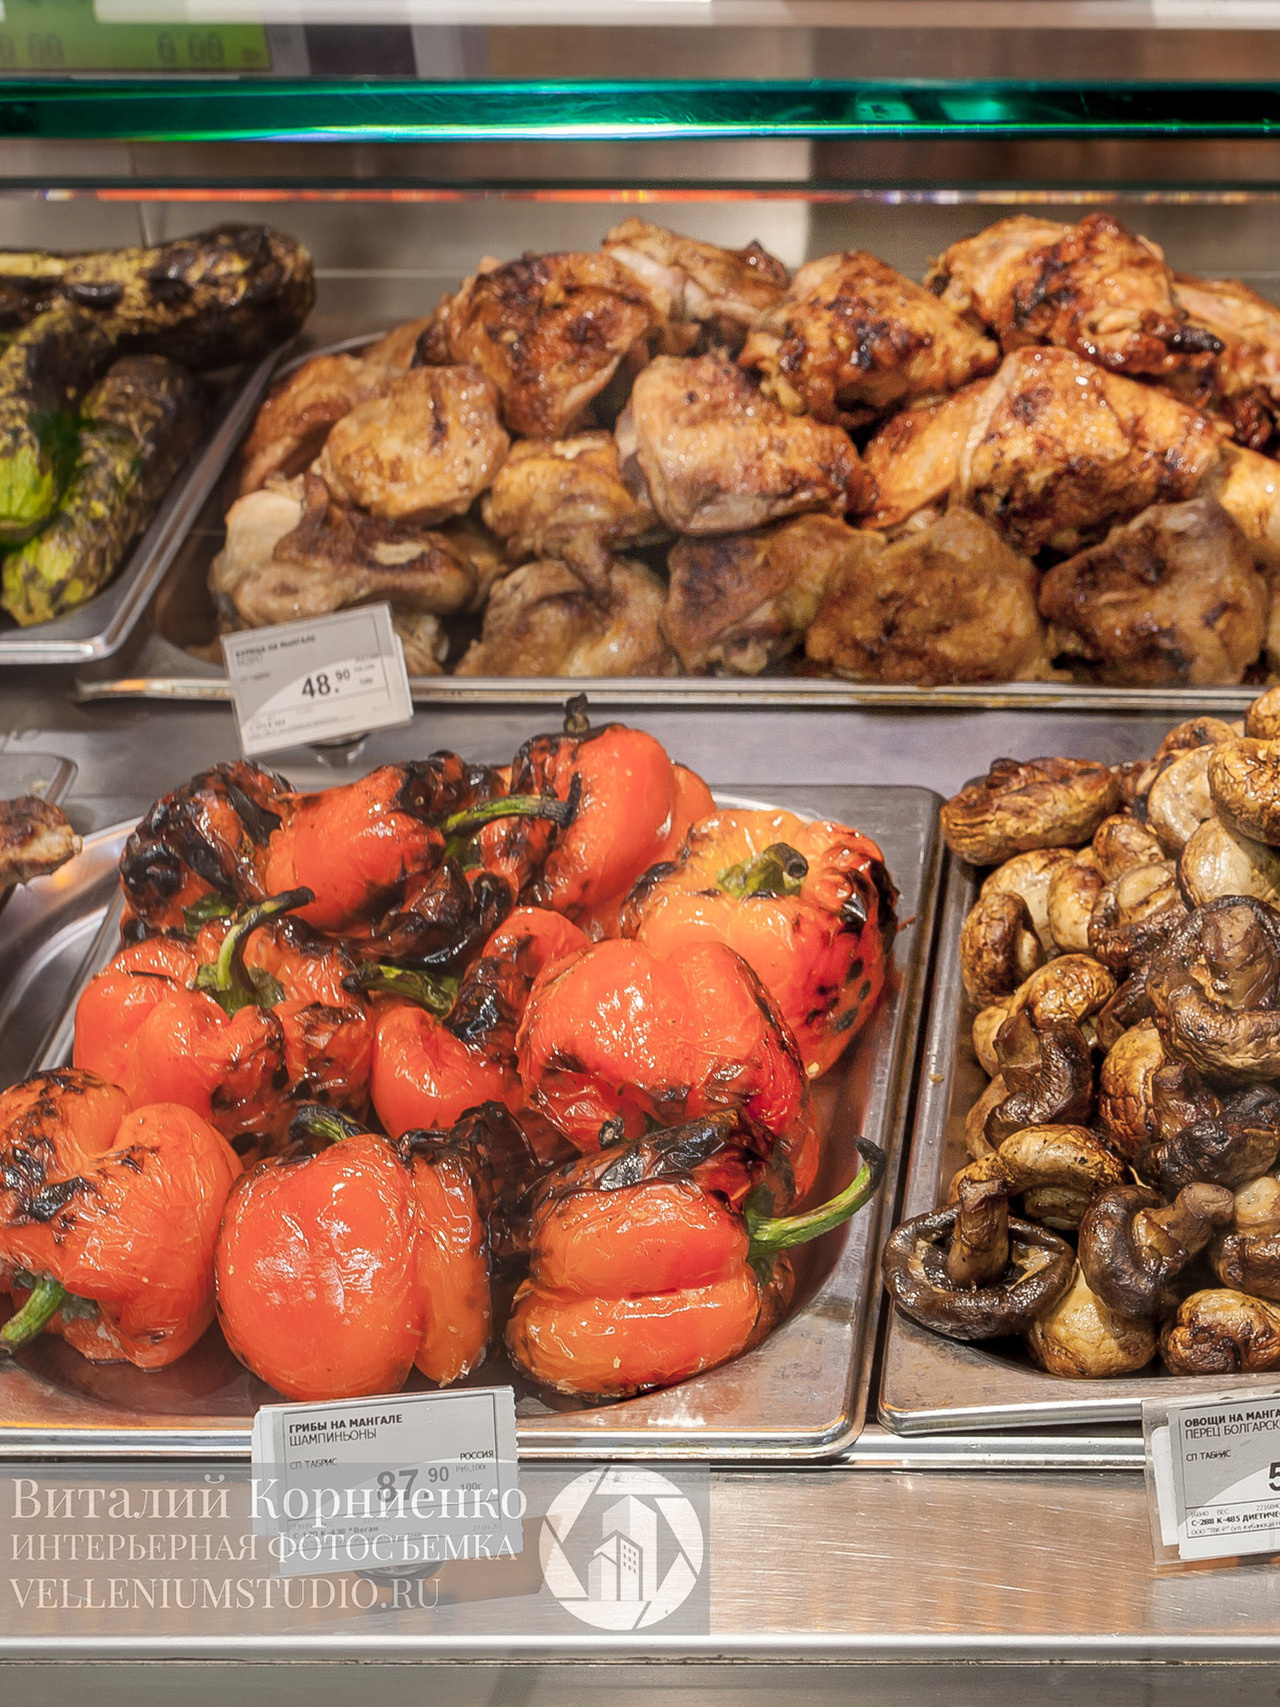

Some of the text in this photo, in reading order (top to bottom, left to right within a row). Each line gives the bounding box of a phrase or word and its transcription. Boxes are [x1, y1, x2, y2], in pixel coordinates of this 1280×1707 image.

[289, 1413, 403, 1434] ГРИБЫ НА МАНГАЛЕ
[1184, 1415, 1226, 1428] ОВОЩИ
[1229, 1412, 1244, 1423] НА
[289, 1428, 377, 1447] ШАМПИНЬОНЫ
[1185, 1425, 1221, 1440] ПЕРЕЦ
[459, 1449, 494, 1460] РОССИЯ
[1186, 1449, 1232, 1462] СП ТАБРИС
[290, 1457, 338, 1470] СП ТАБРИС
